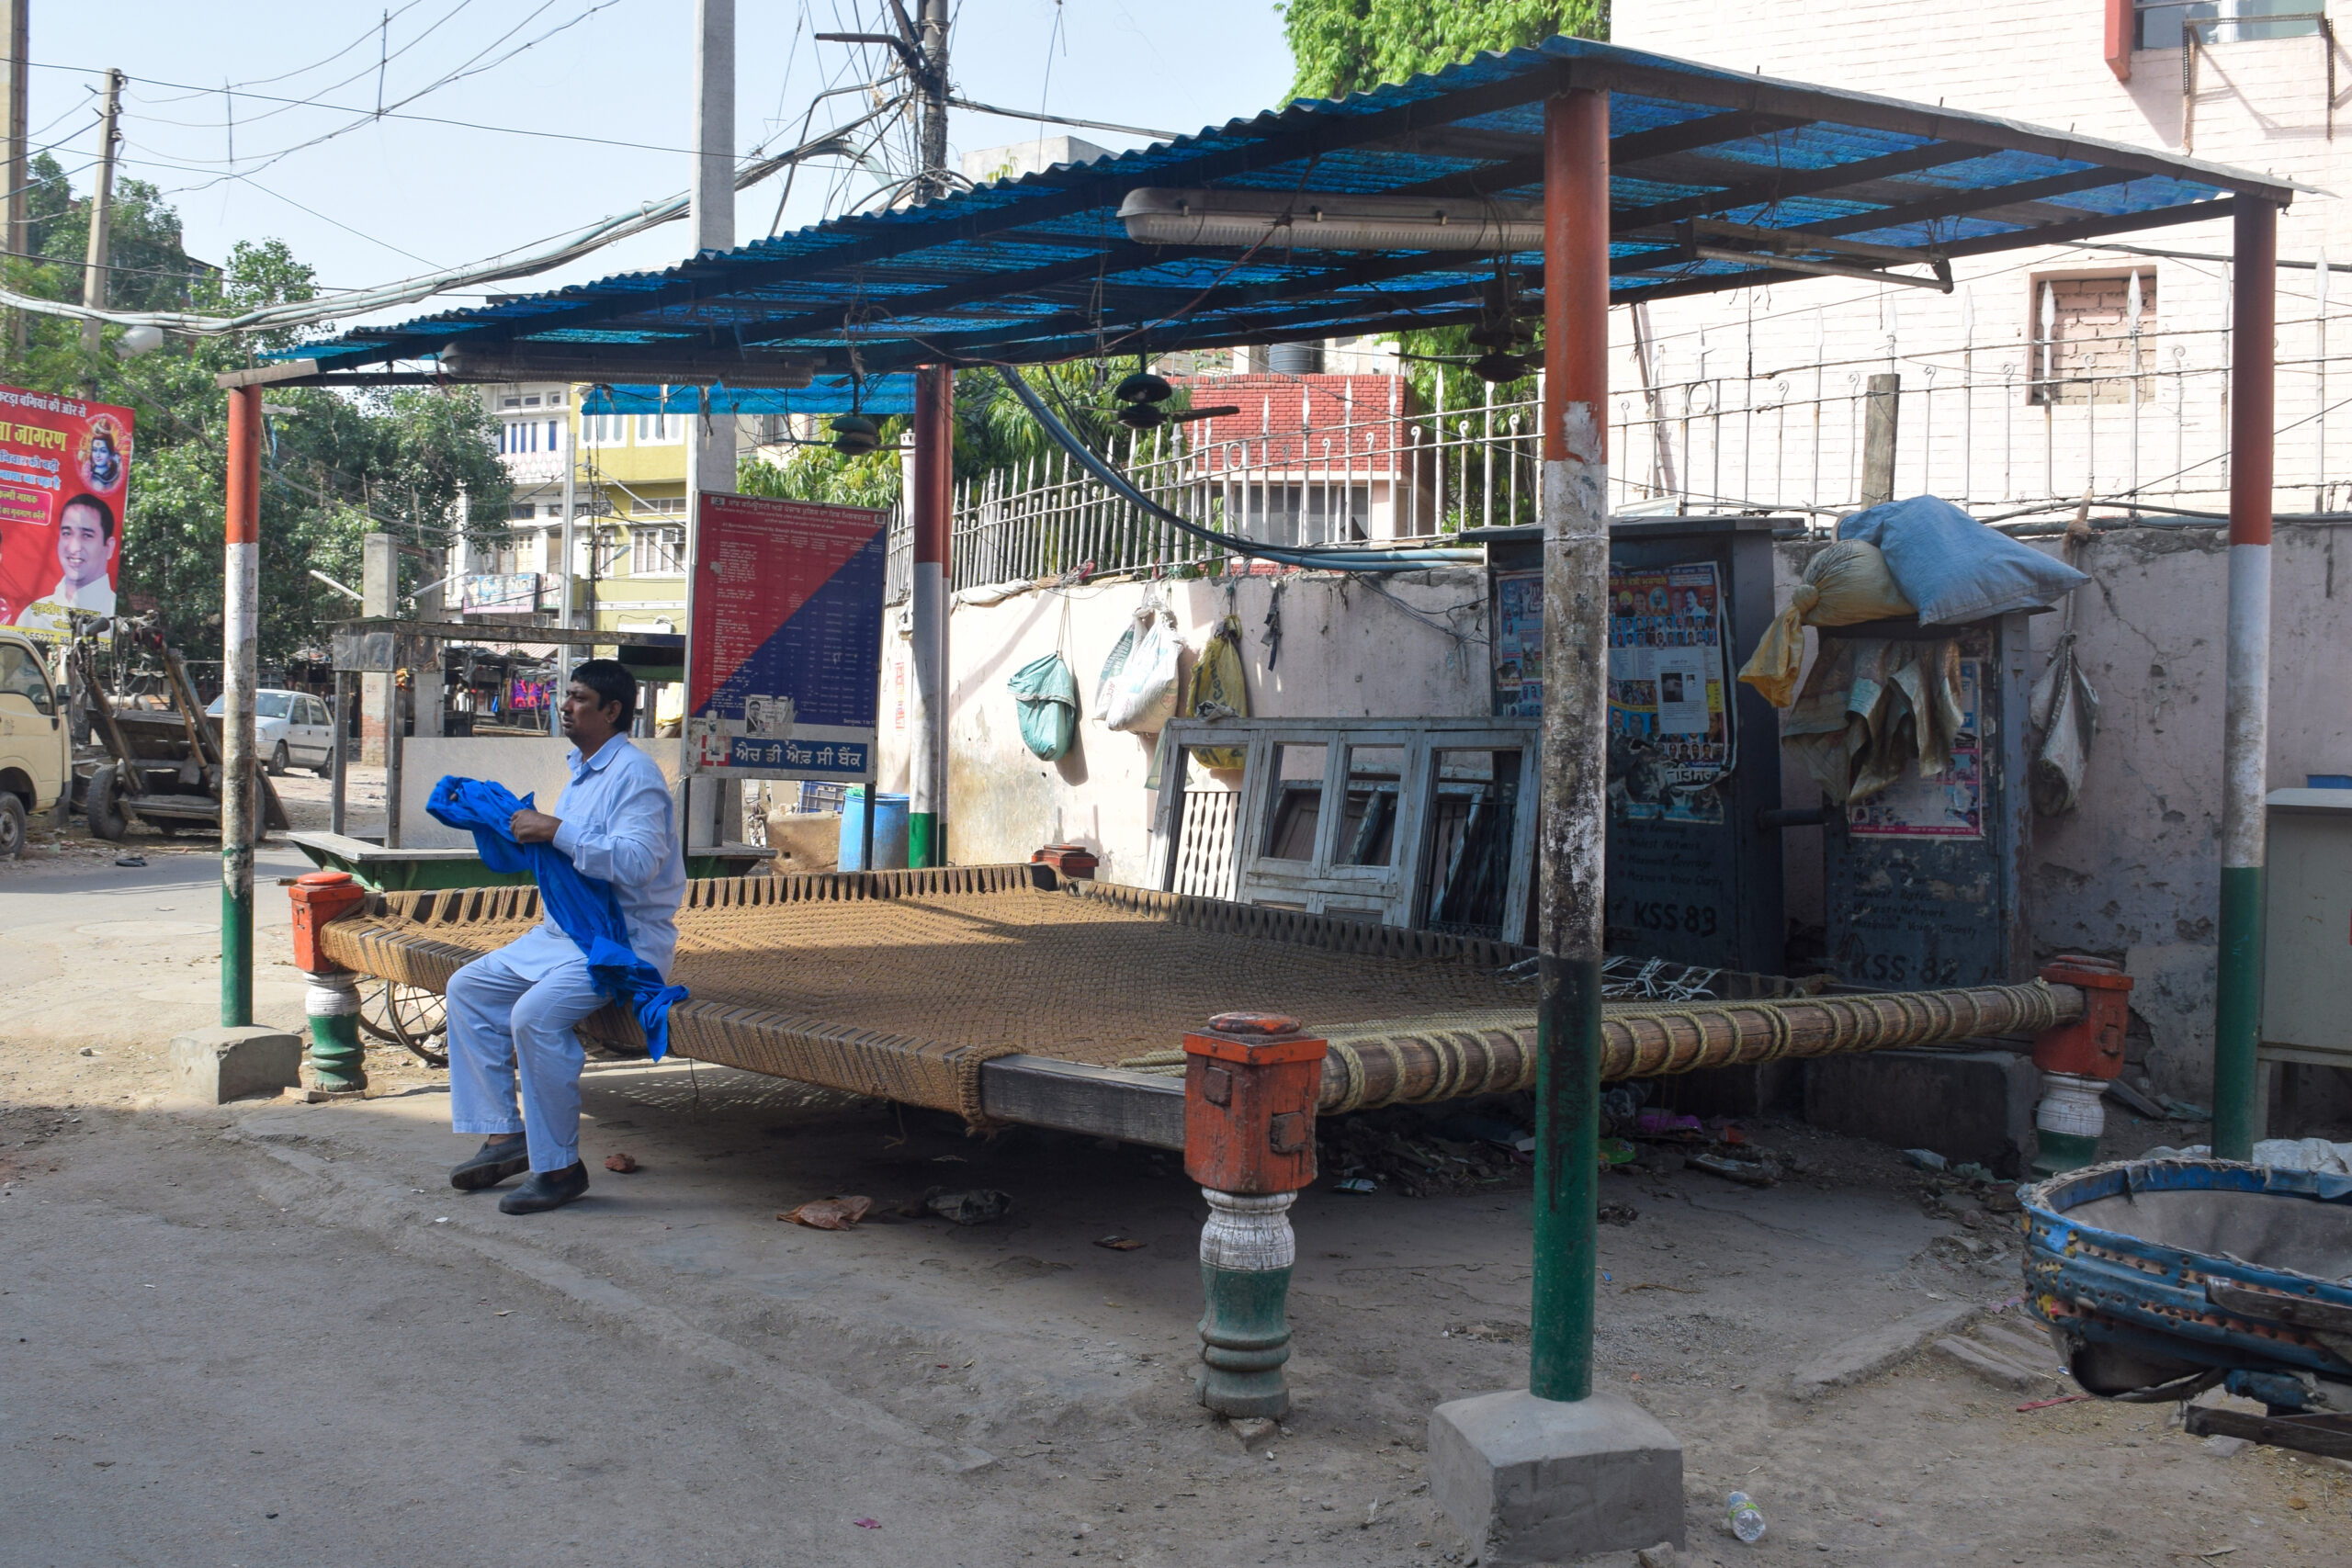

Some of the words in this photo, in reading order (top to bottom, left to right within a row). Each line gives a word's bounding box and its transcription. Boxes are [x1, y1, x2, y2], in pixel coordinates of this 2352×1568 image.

[15, 423, 68, 451] जागरण
[736, 741, 762, 761] ਐਚ
[765, 744, 782, 763] ਡੀ
[816, 747, 833, 765] ਸੀ
[838, 747, 862, 767] ਬੈਂਕ
